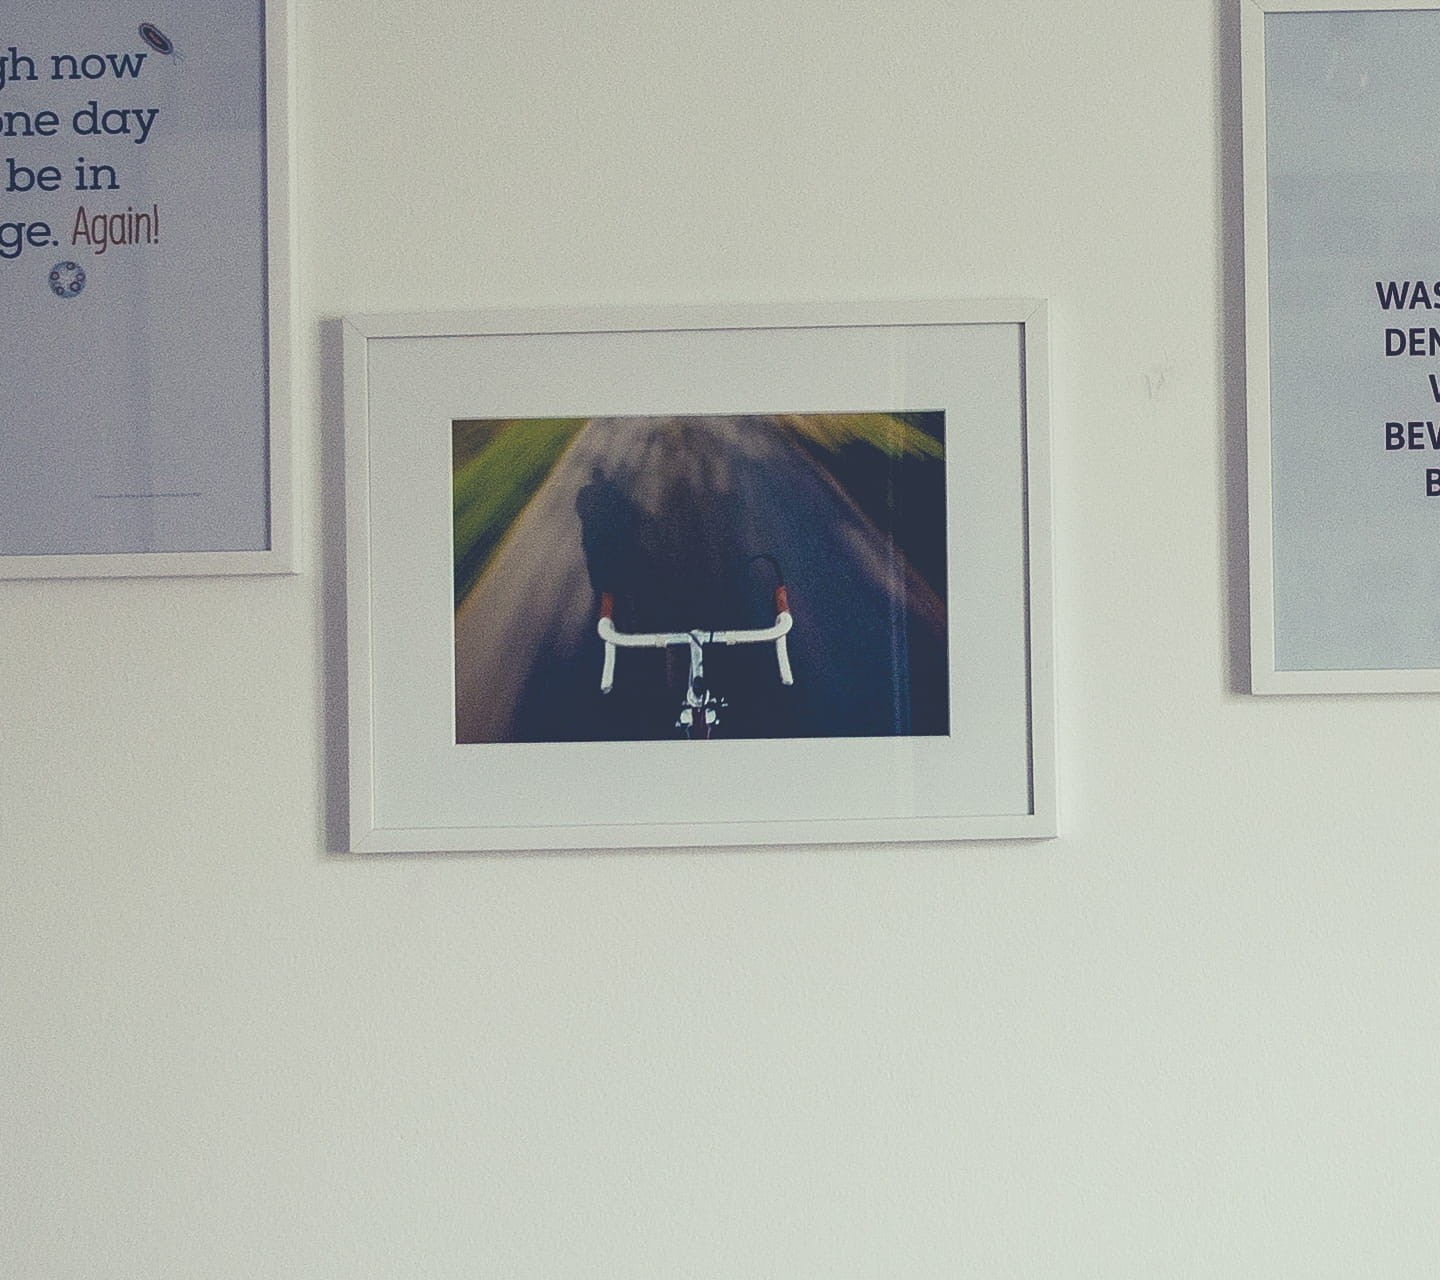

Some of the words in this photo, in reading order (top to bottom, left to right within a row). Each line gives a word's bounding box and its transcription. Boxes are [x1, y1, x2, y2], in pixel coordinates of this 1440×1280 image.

[50, 53, 148, 81] now
[72, 100, 160, 145] day
[5, 157, 63, 193] be
[74, 156, 121, 191] in
[71, 204, 160, 255] Again!
